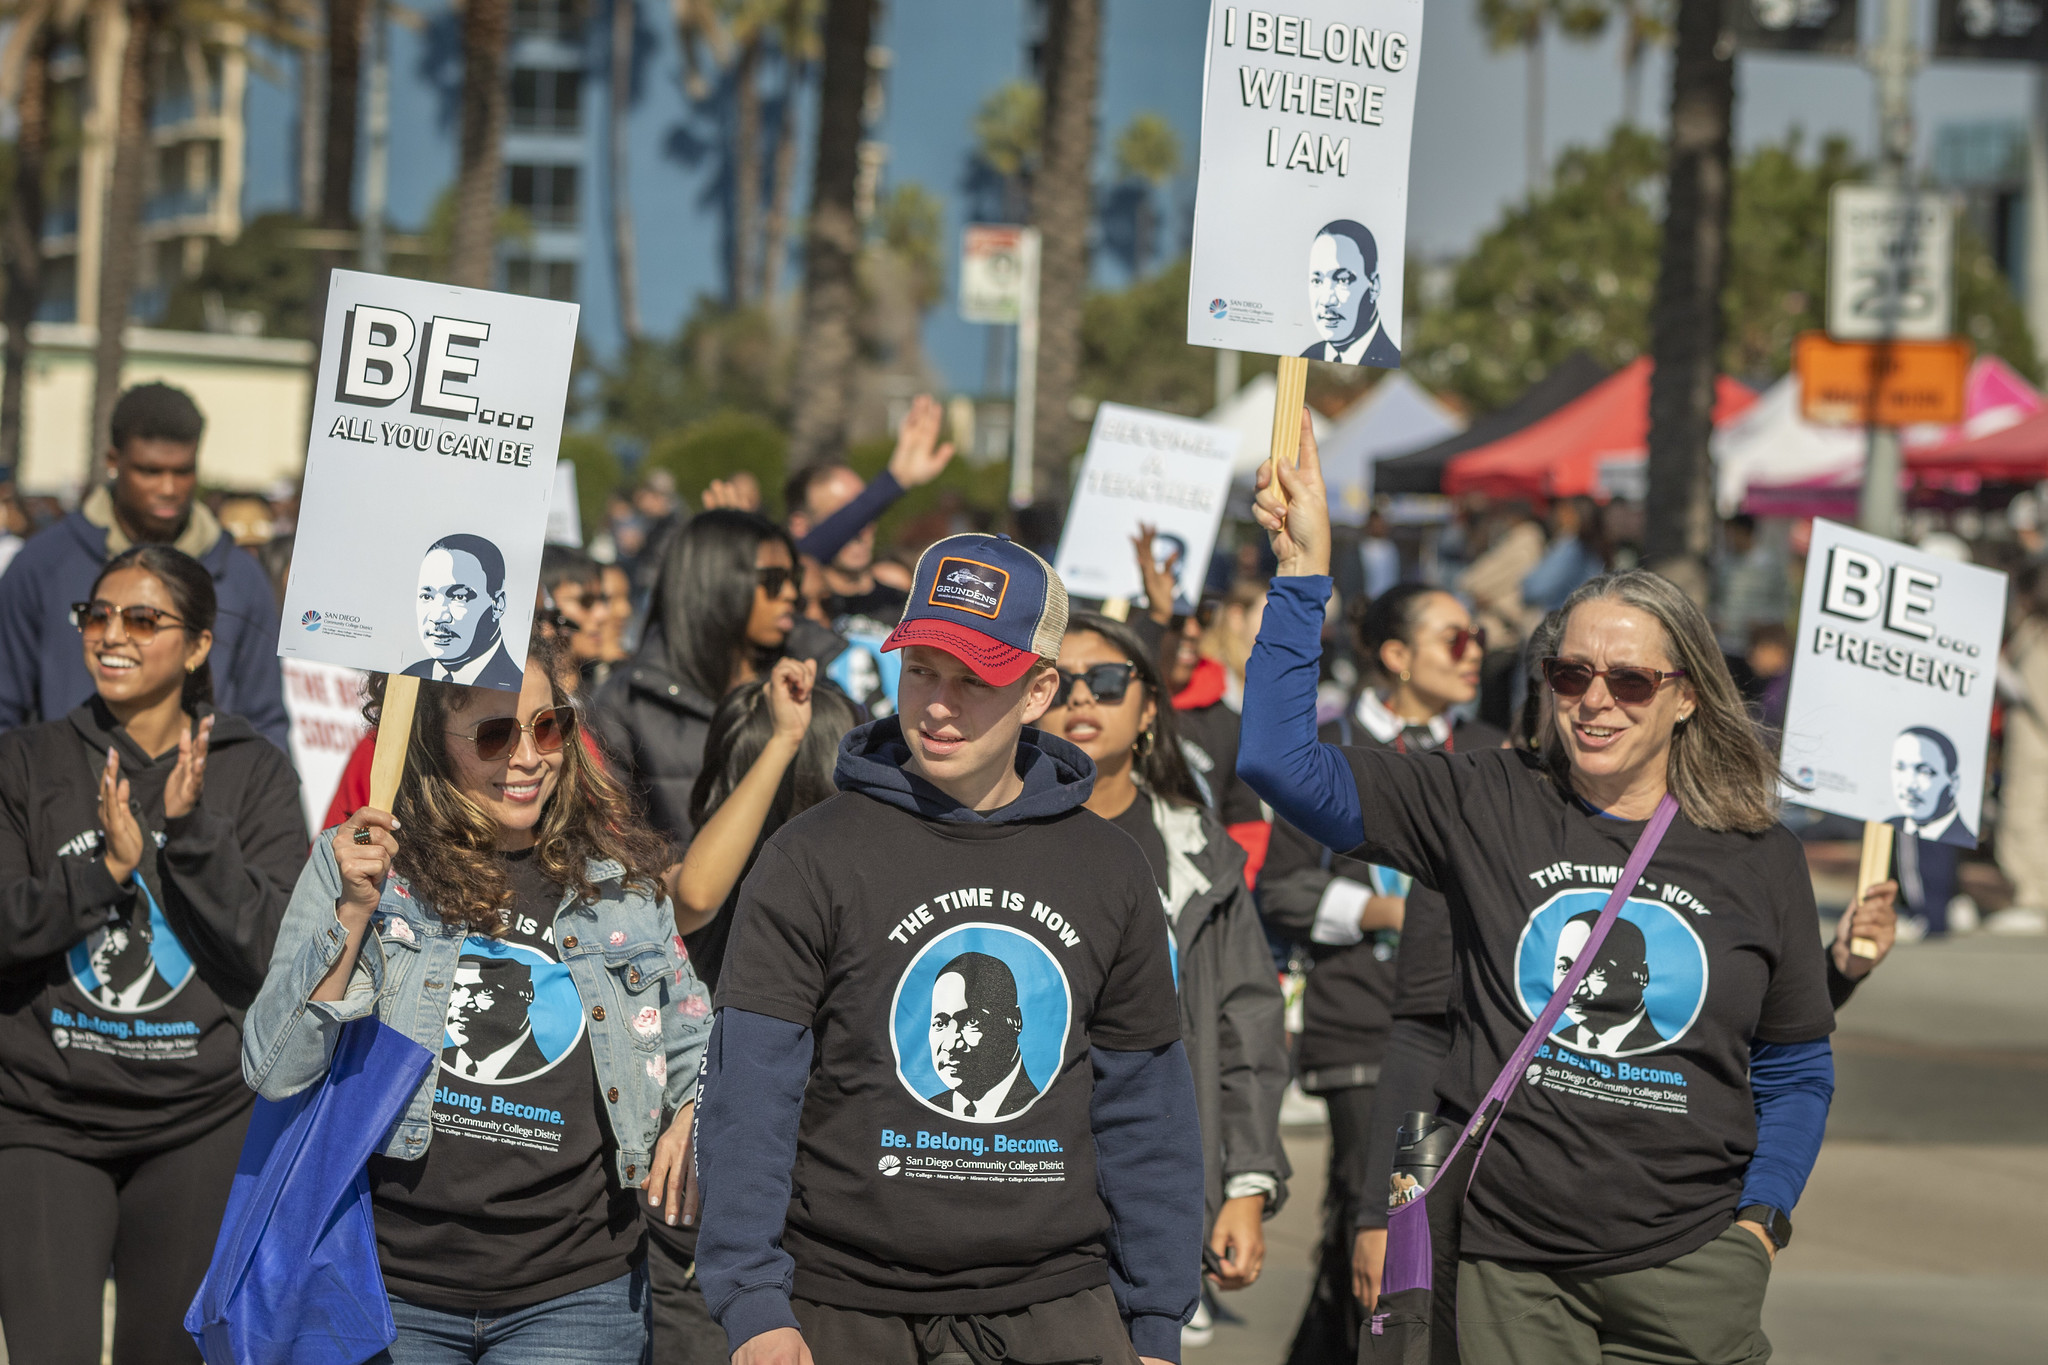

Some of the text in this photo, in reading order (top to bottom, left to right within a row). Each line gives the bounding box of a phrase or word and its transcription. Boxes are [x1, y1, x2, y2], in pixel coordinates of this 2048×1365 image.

[1224, 6, 1408, 73] I BELONG
[1239, 65, 1386, 126] WHERE
[1267, 127, 1350, 177] I AM
[1243, 301, 1263, 309] DIEGO
[335, 303, 534, 431] BE...
[329, 415, 534, 467] ALL YOU CAN BE
[339, 613, 361, 623] DIEGO
[1820, 543, 1980, 658] BE...
[1812, 624, 1978, 697] PRESENT
[1528, 860, 1573, 889] THE
[1573, 864, 1625, 884] TIM
[1660, 883, 1712, 916] NOW
[515, 912, 538, 936] IS
[888, 887, 1081, 948] THE TIME IS NOW
[50, 1007, 76, 1027] Be.
[134, 1019, 200, 1038] Become.
[105, 1037, 147, 1051] ommunity
[1534, 1045, 1553, 1060] e.
[1618, 1062, 1687, 1087] Become.
[1545, 1066, 1560, 1078] San
[1561, 1070, 1585, 1085] Diego
[1633, 1087, 1662, 1101] College
[434, 1086, 565, 1125] elong. Become.
[452, 1113, 501, 1133] Community
[502, 1124, 533, 1138] College
[534, 1128, 561, 1142] District
[881, 1129, 1064, 1156] Be. Belong. Become.
[905, 1156, 1065, 1172] San Diego Community College District
